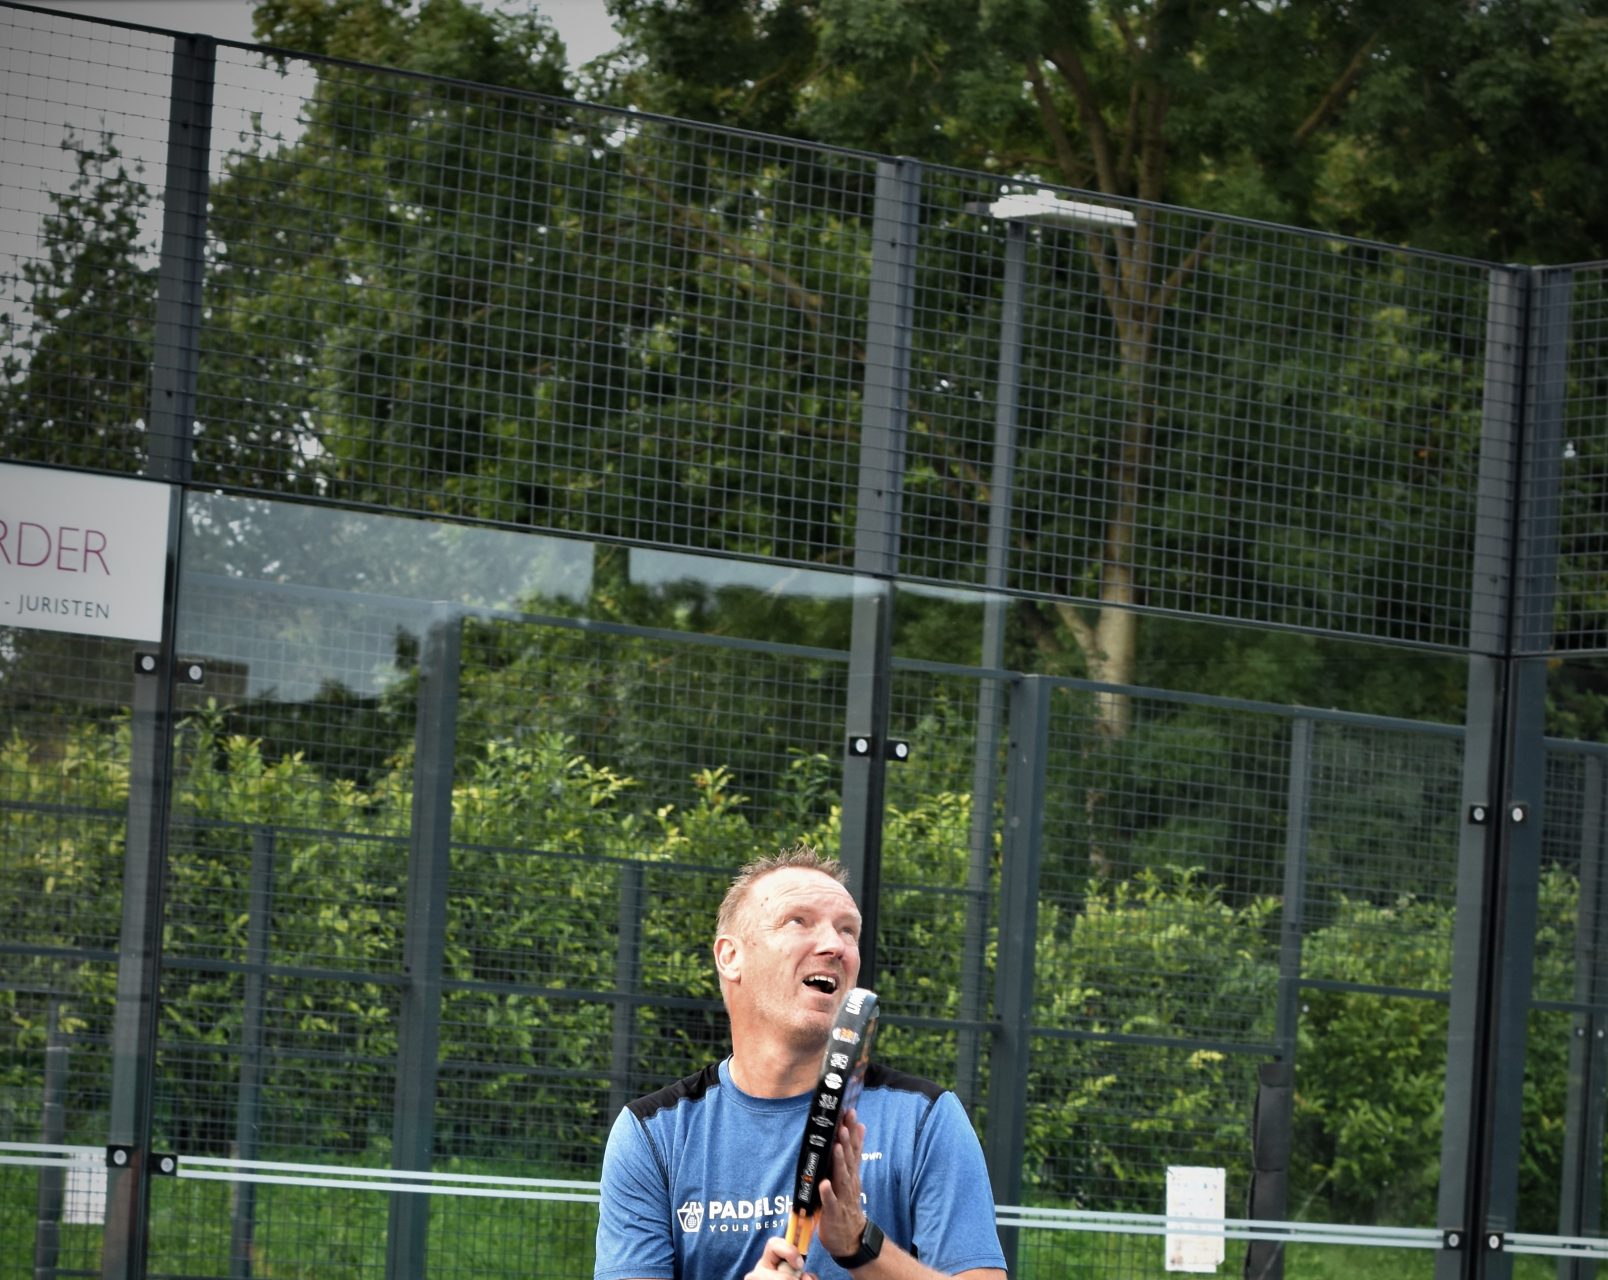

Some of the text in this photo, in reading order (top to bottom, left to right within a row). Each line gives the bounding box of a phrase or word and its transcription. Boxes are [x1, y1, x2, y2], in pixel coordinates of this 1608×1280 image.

[17, 594, 110, 619] JURISTEN
[709, 1219, 785, 1232] YOUR BEST
